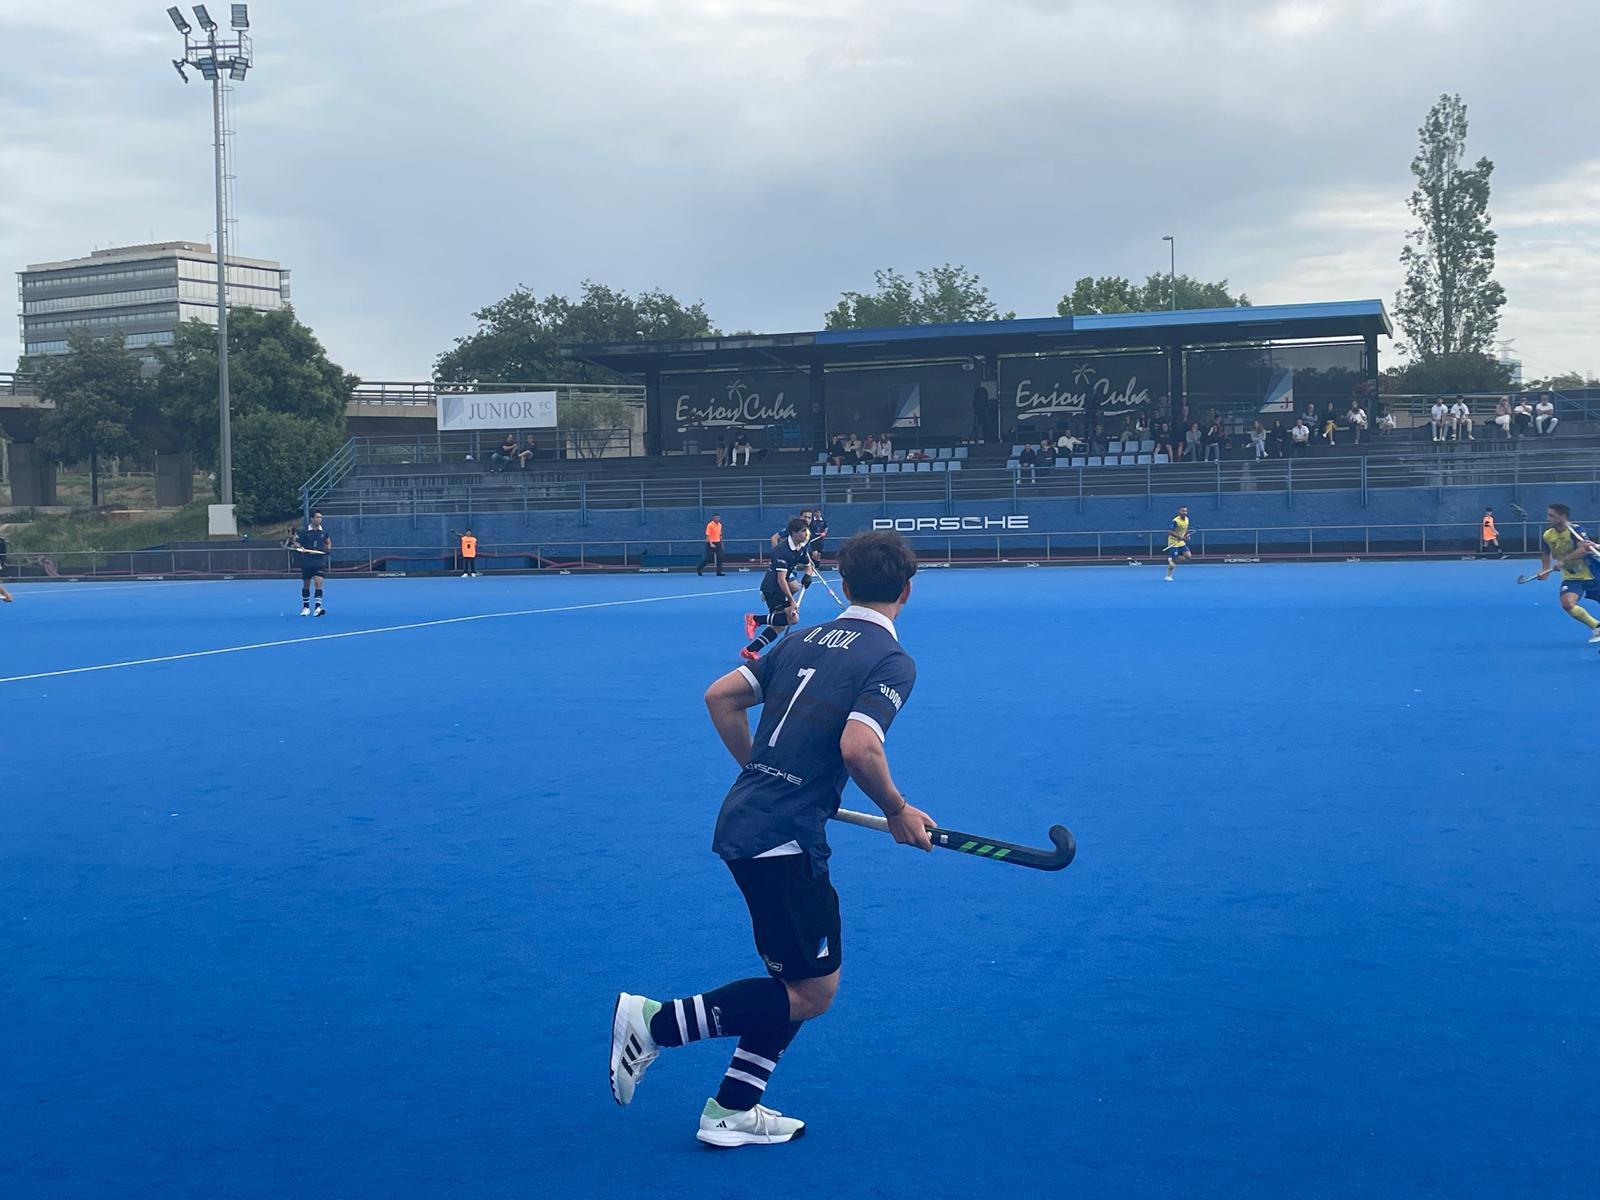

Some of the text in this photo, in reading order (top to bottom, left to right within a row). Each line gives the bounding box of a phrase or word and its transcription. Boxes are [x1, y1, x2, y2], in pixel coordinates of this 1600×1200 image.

[676, 392, 798, 422] Enjoy Cuba
[1016, 380, 1086, 410] Enjoy
[468, 401, 534, 420] JUNIOR
[872, 515, 1029, 532] PORSCHE
